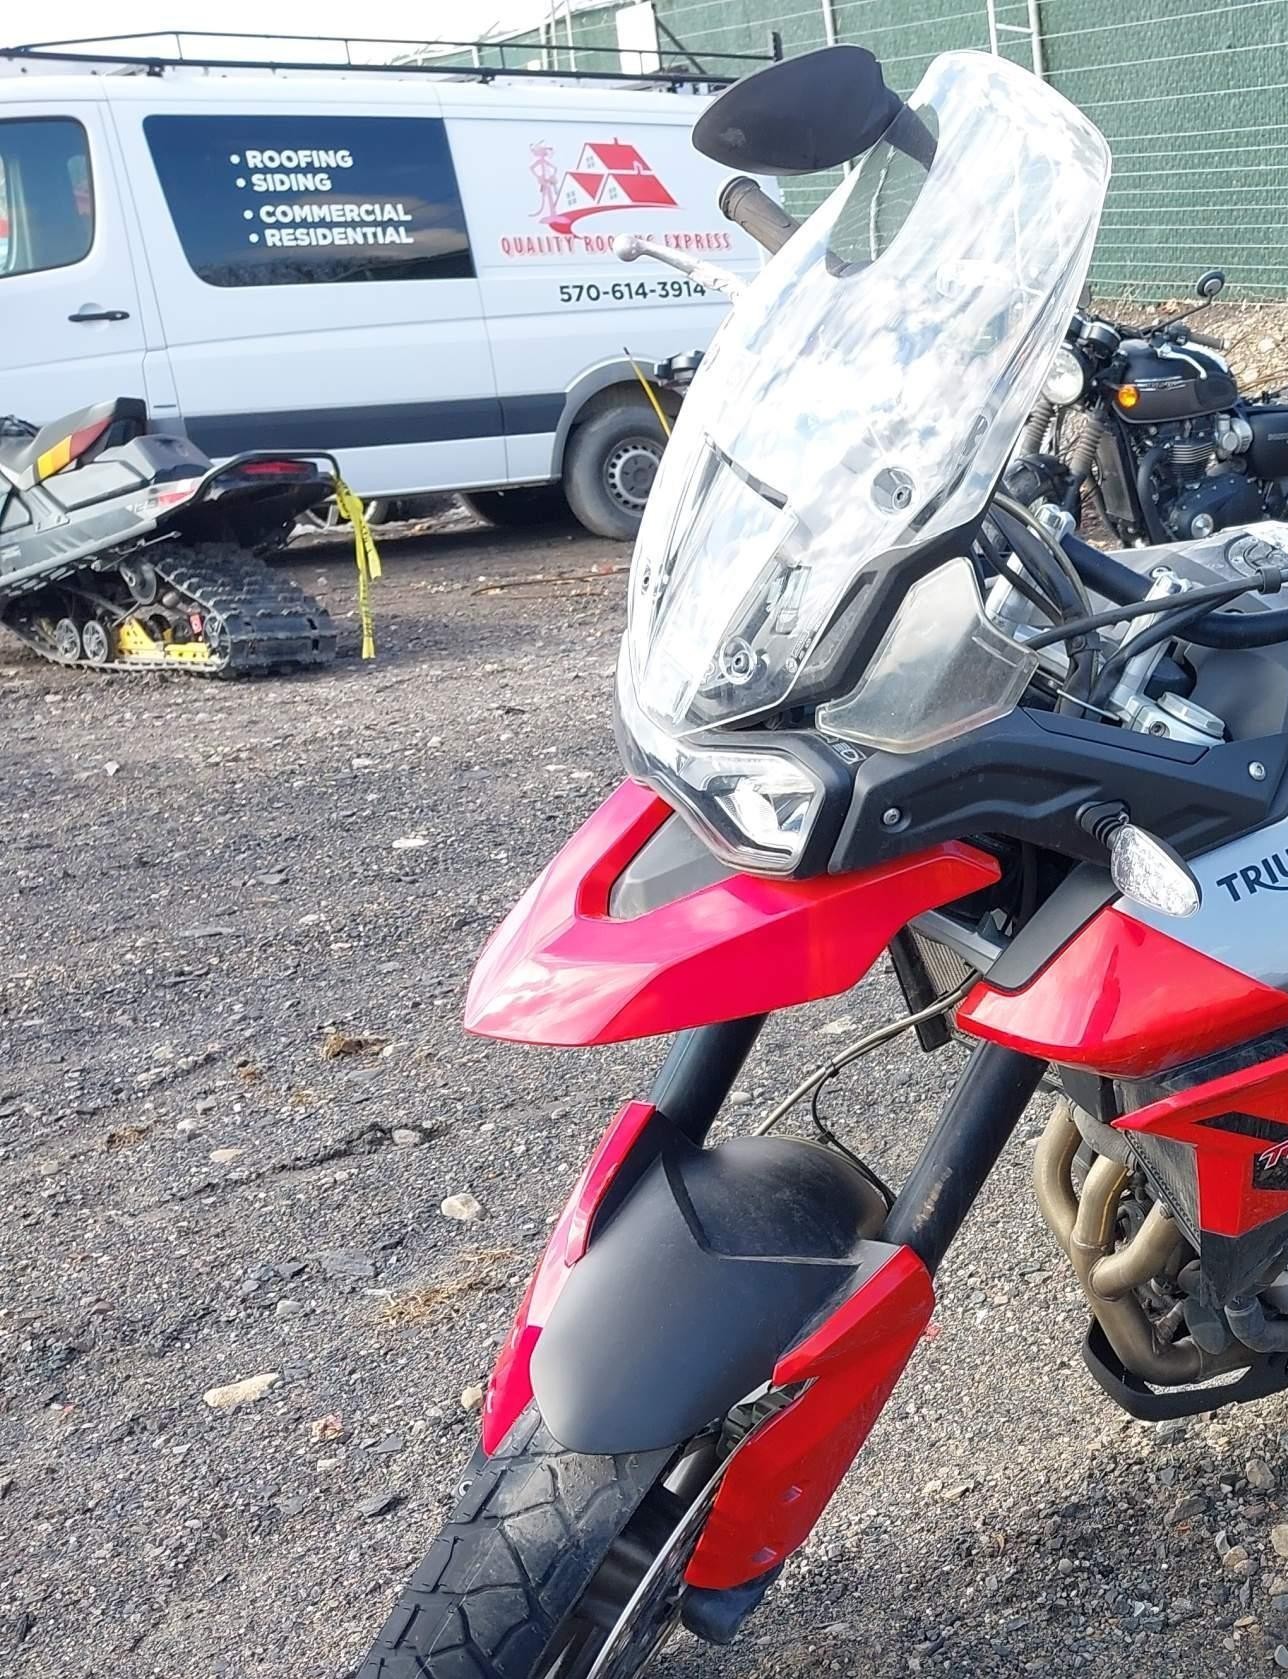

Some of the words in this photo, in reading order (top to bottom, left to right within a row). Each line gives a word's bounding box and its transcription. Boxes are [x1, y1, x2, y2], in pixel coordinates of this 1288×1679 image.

[245, 150, 354, 168] ROOFING
[251, 173, 332, 191] SIDING
[259, 204, 412, 223] COMMERCIAL
[264, 226, 415, 246] RESIDENTIAL
[501, 236, 573, 255] QUALITY
[664, 233, 730, 249] EXPRESS
[559, 281, 706, 302] 570-614-3914
